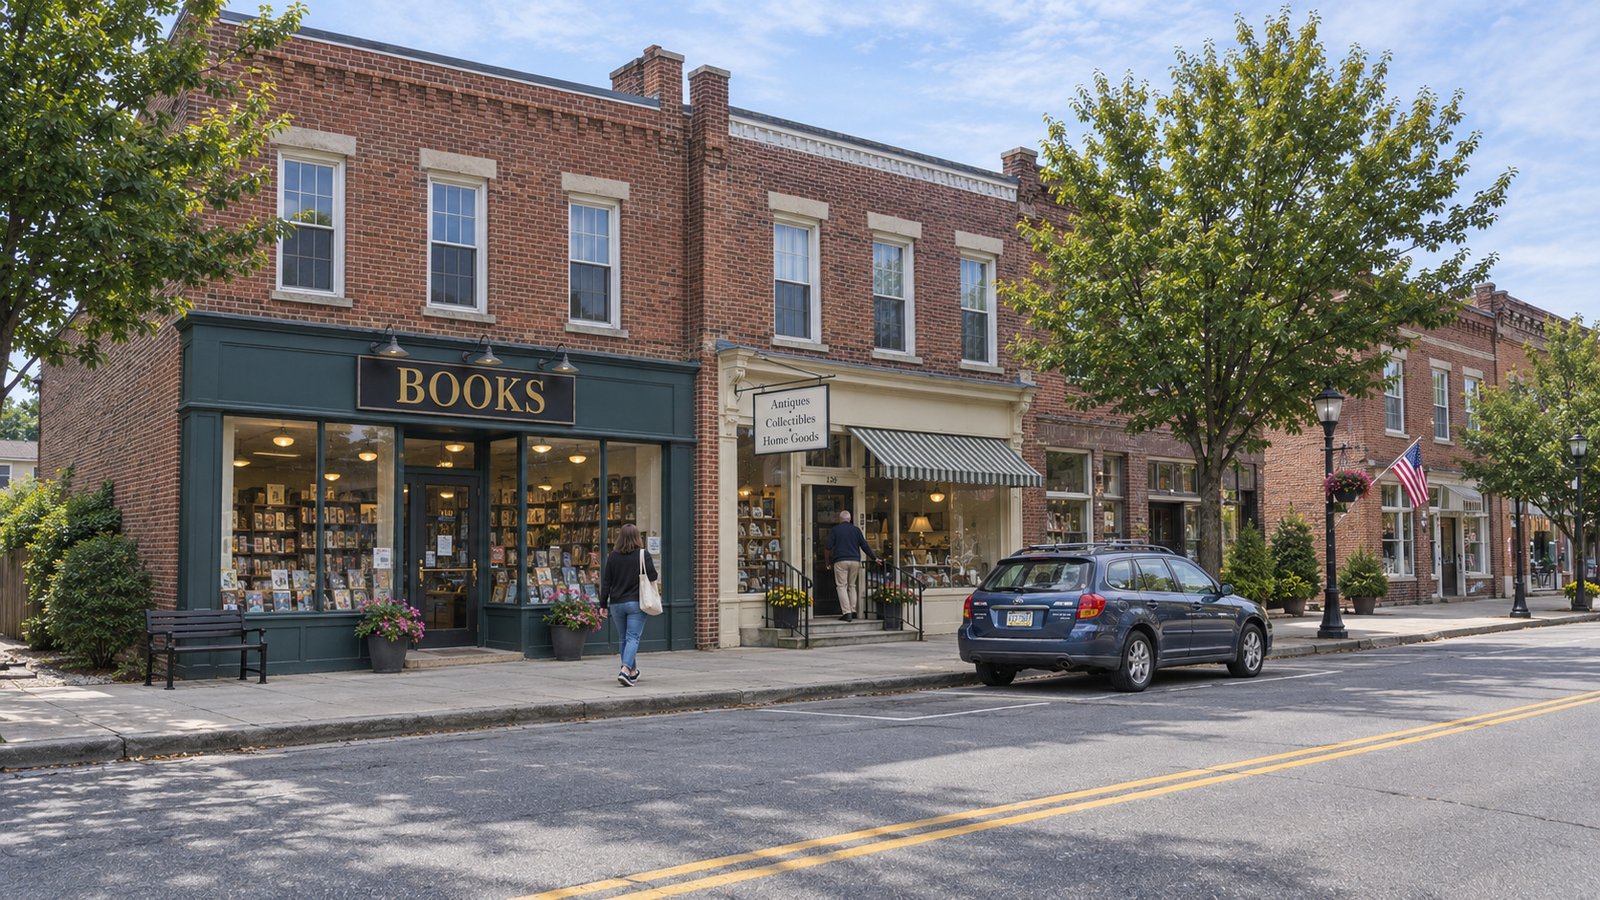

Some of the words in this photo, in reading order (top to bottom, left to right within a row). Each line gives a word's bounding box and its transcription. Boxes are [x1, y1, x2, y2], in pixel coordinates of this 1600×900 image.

[396, 366, 546, 414] BOOKS
[771, 397, 810, 410] Antiques
[765, 413, 816, 428] Collectibles
[763, 435, 788, 446] Home
[790, 431, 819, 443] Goods
